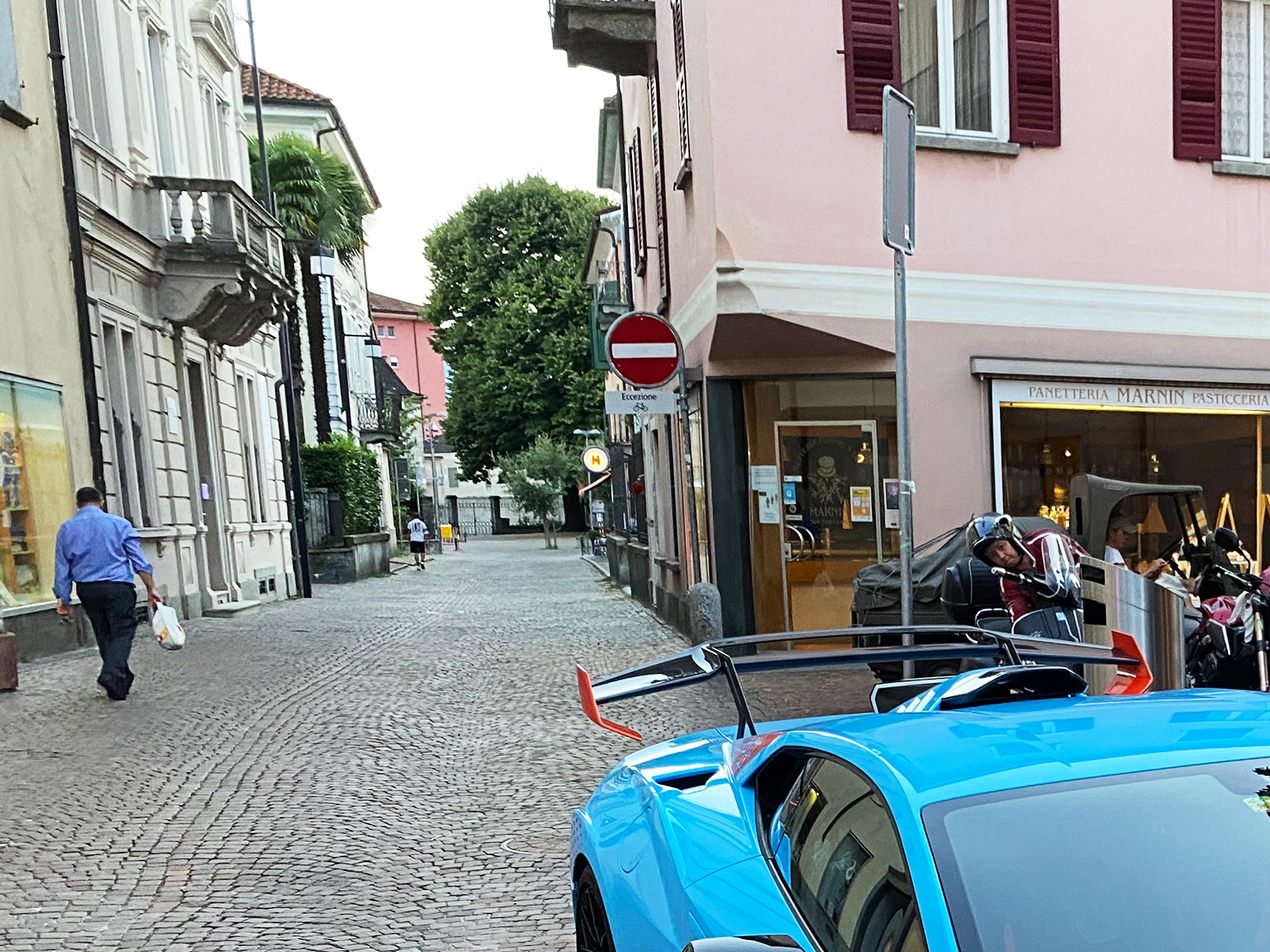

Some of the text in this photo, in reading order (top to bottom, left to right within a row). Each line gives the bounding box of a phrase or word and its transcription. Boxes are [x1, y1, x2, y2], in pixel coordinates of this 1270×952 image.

[621, 392, 658, 401] Eccezione
[1029, 386, 1270, 406] PANETTERIA MARNIN PASTICCERIA
[591, 454, 601, 466] H
